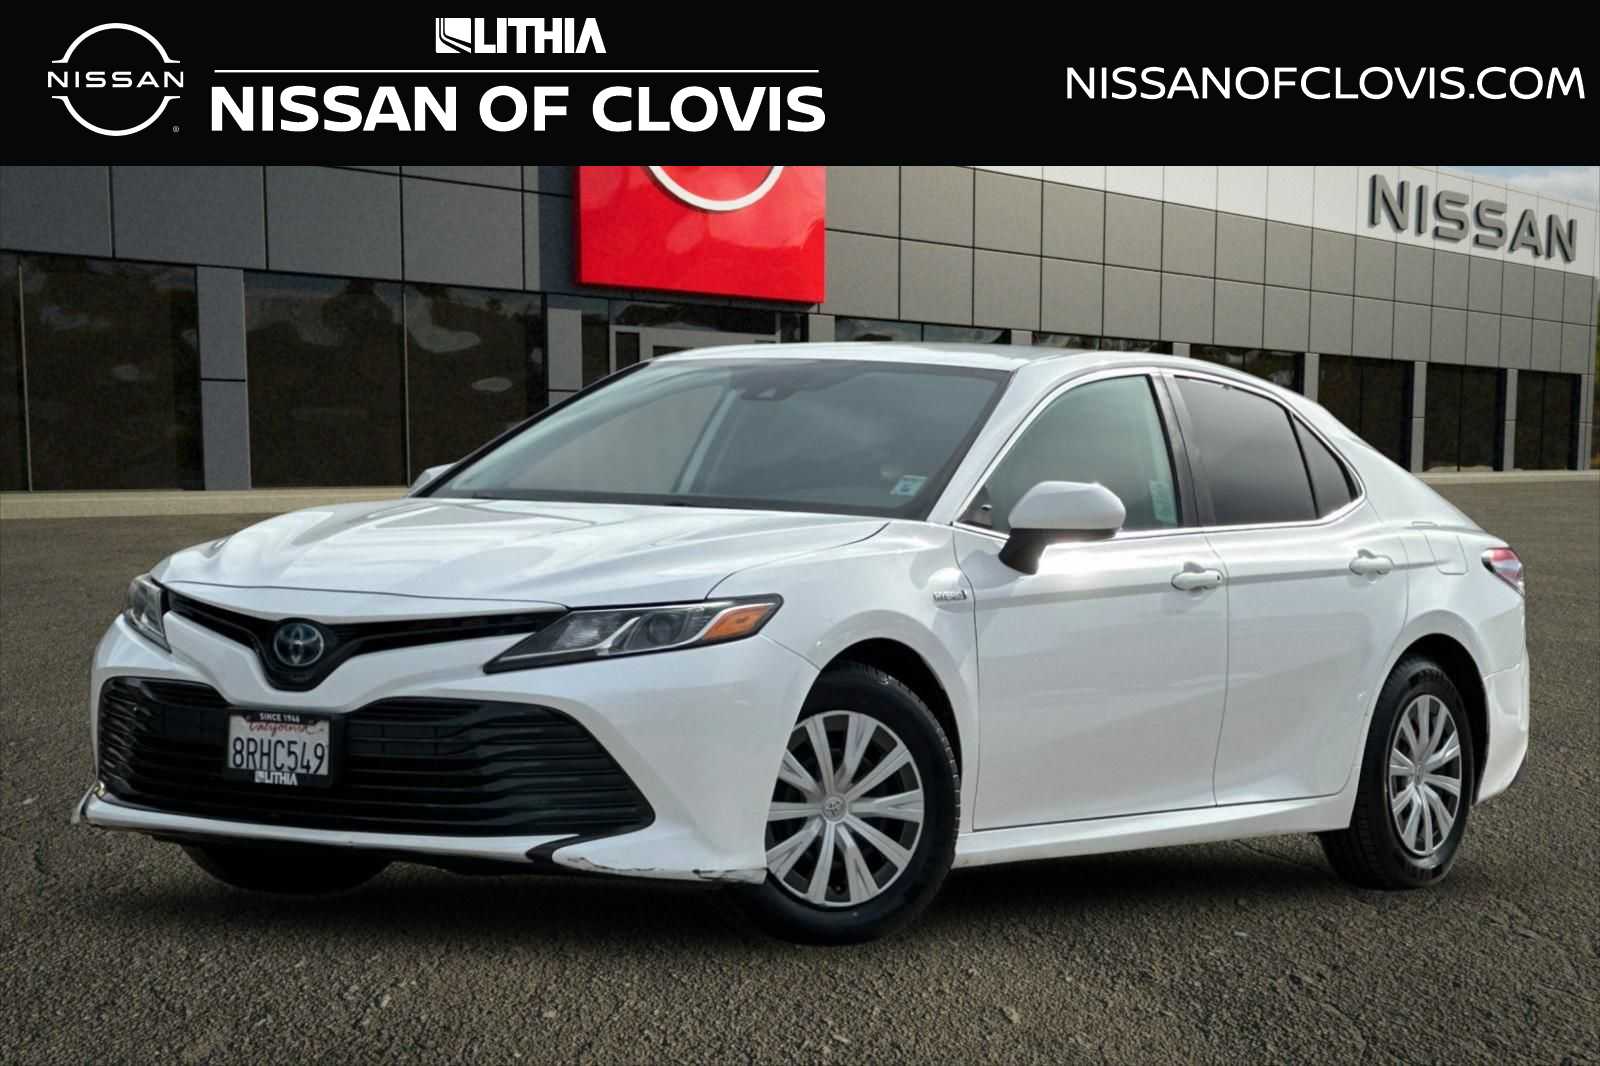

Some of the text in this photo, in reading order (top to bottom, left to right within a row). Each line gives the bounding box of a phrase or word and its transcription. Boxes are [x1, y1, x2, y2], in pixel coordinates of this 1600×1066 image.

[1368, 174, 1577, 263] NISSAN
[259, 712, 281, 721] SINCE
[233, 737, 325, 774] 8RHC549
[265, 772, 298, 786] LITHIA
